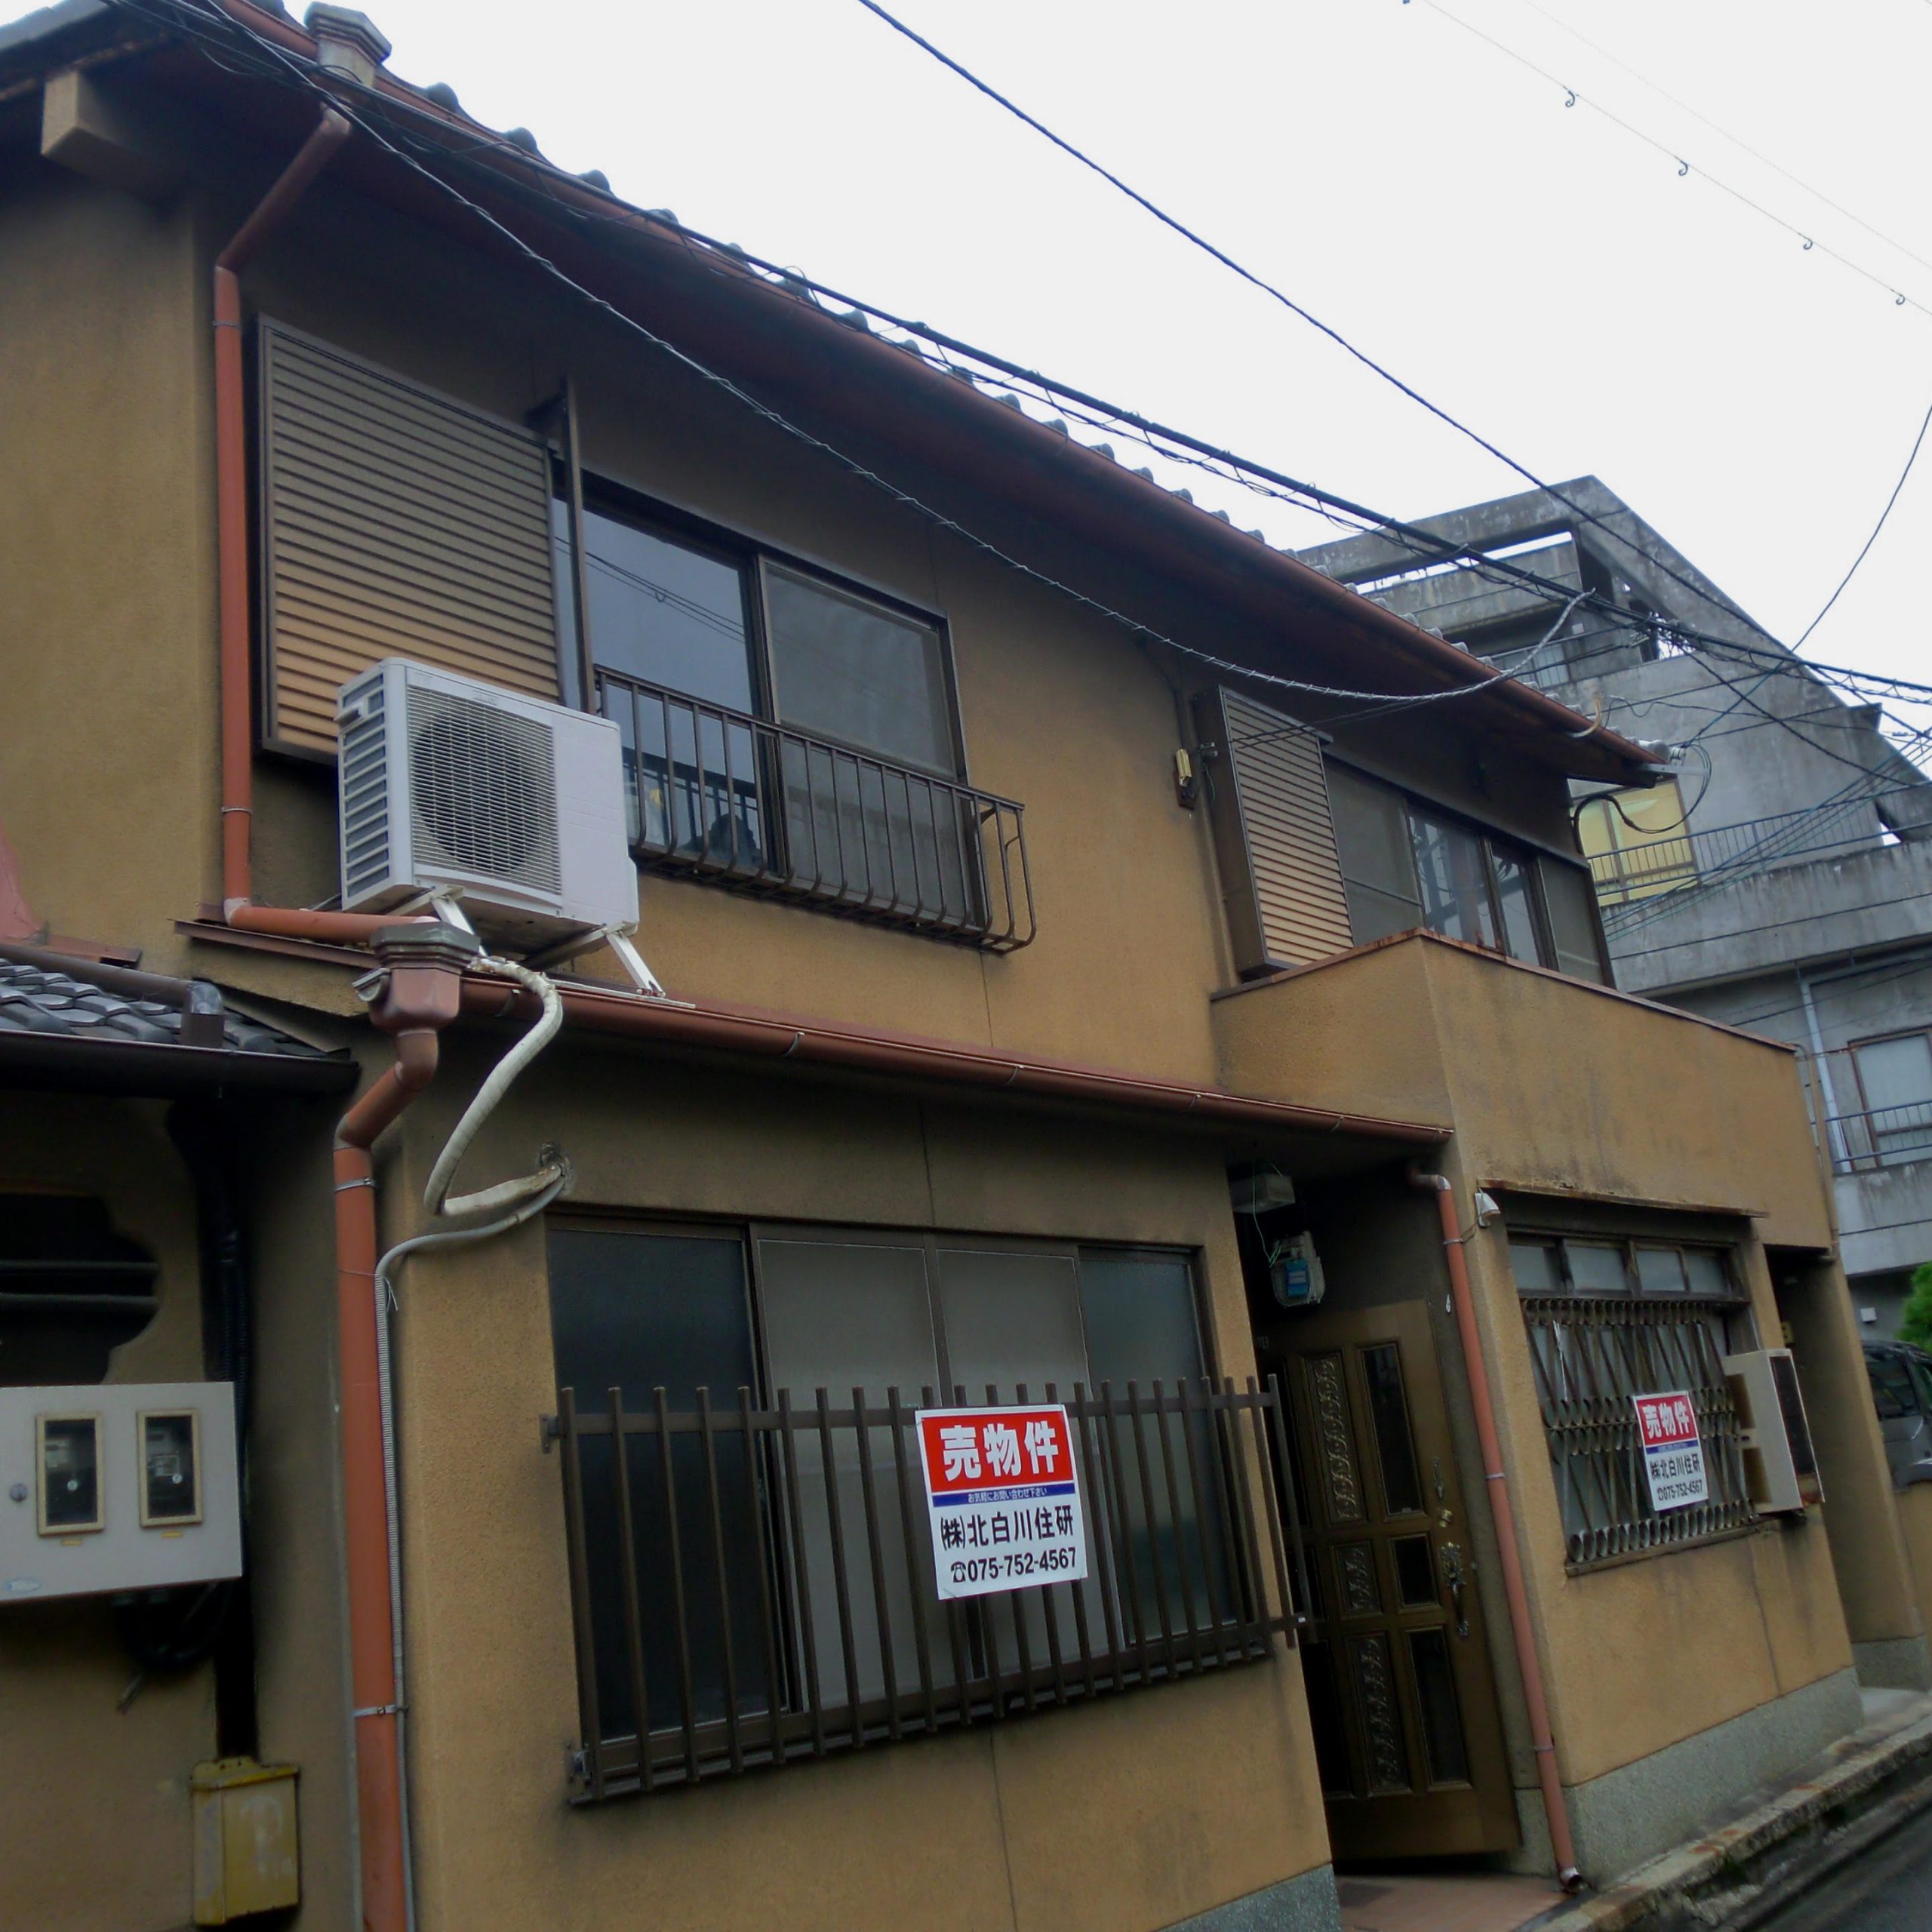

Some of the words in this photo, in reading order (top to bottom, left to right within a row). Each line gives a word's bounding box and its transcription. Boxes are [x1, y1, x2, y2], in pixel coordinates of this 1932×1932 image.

[1642, 1401, 1690, 1439] 売物件
[940, 1420, 1059, 1481] 売物件
[968, 1547, 1076, 1583] 075-752-4567
